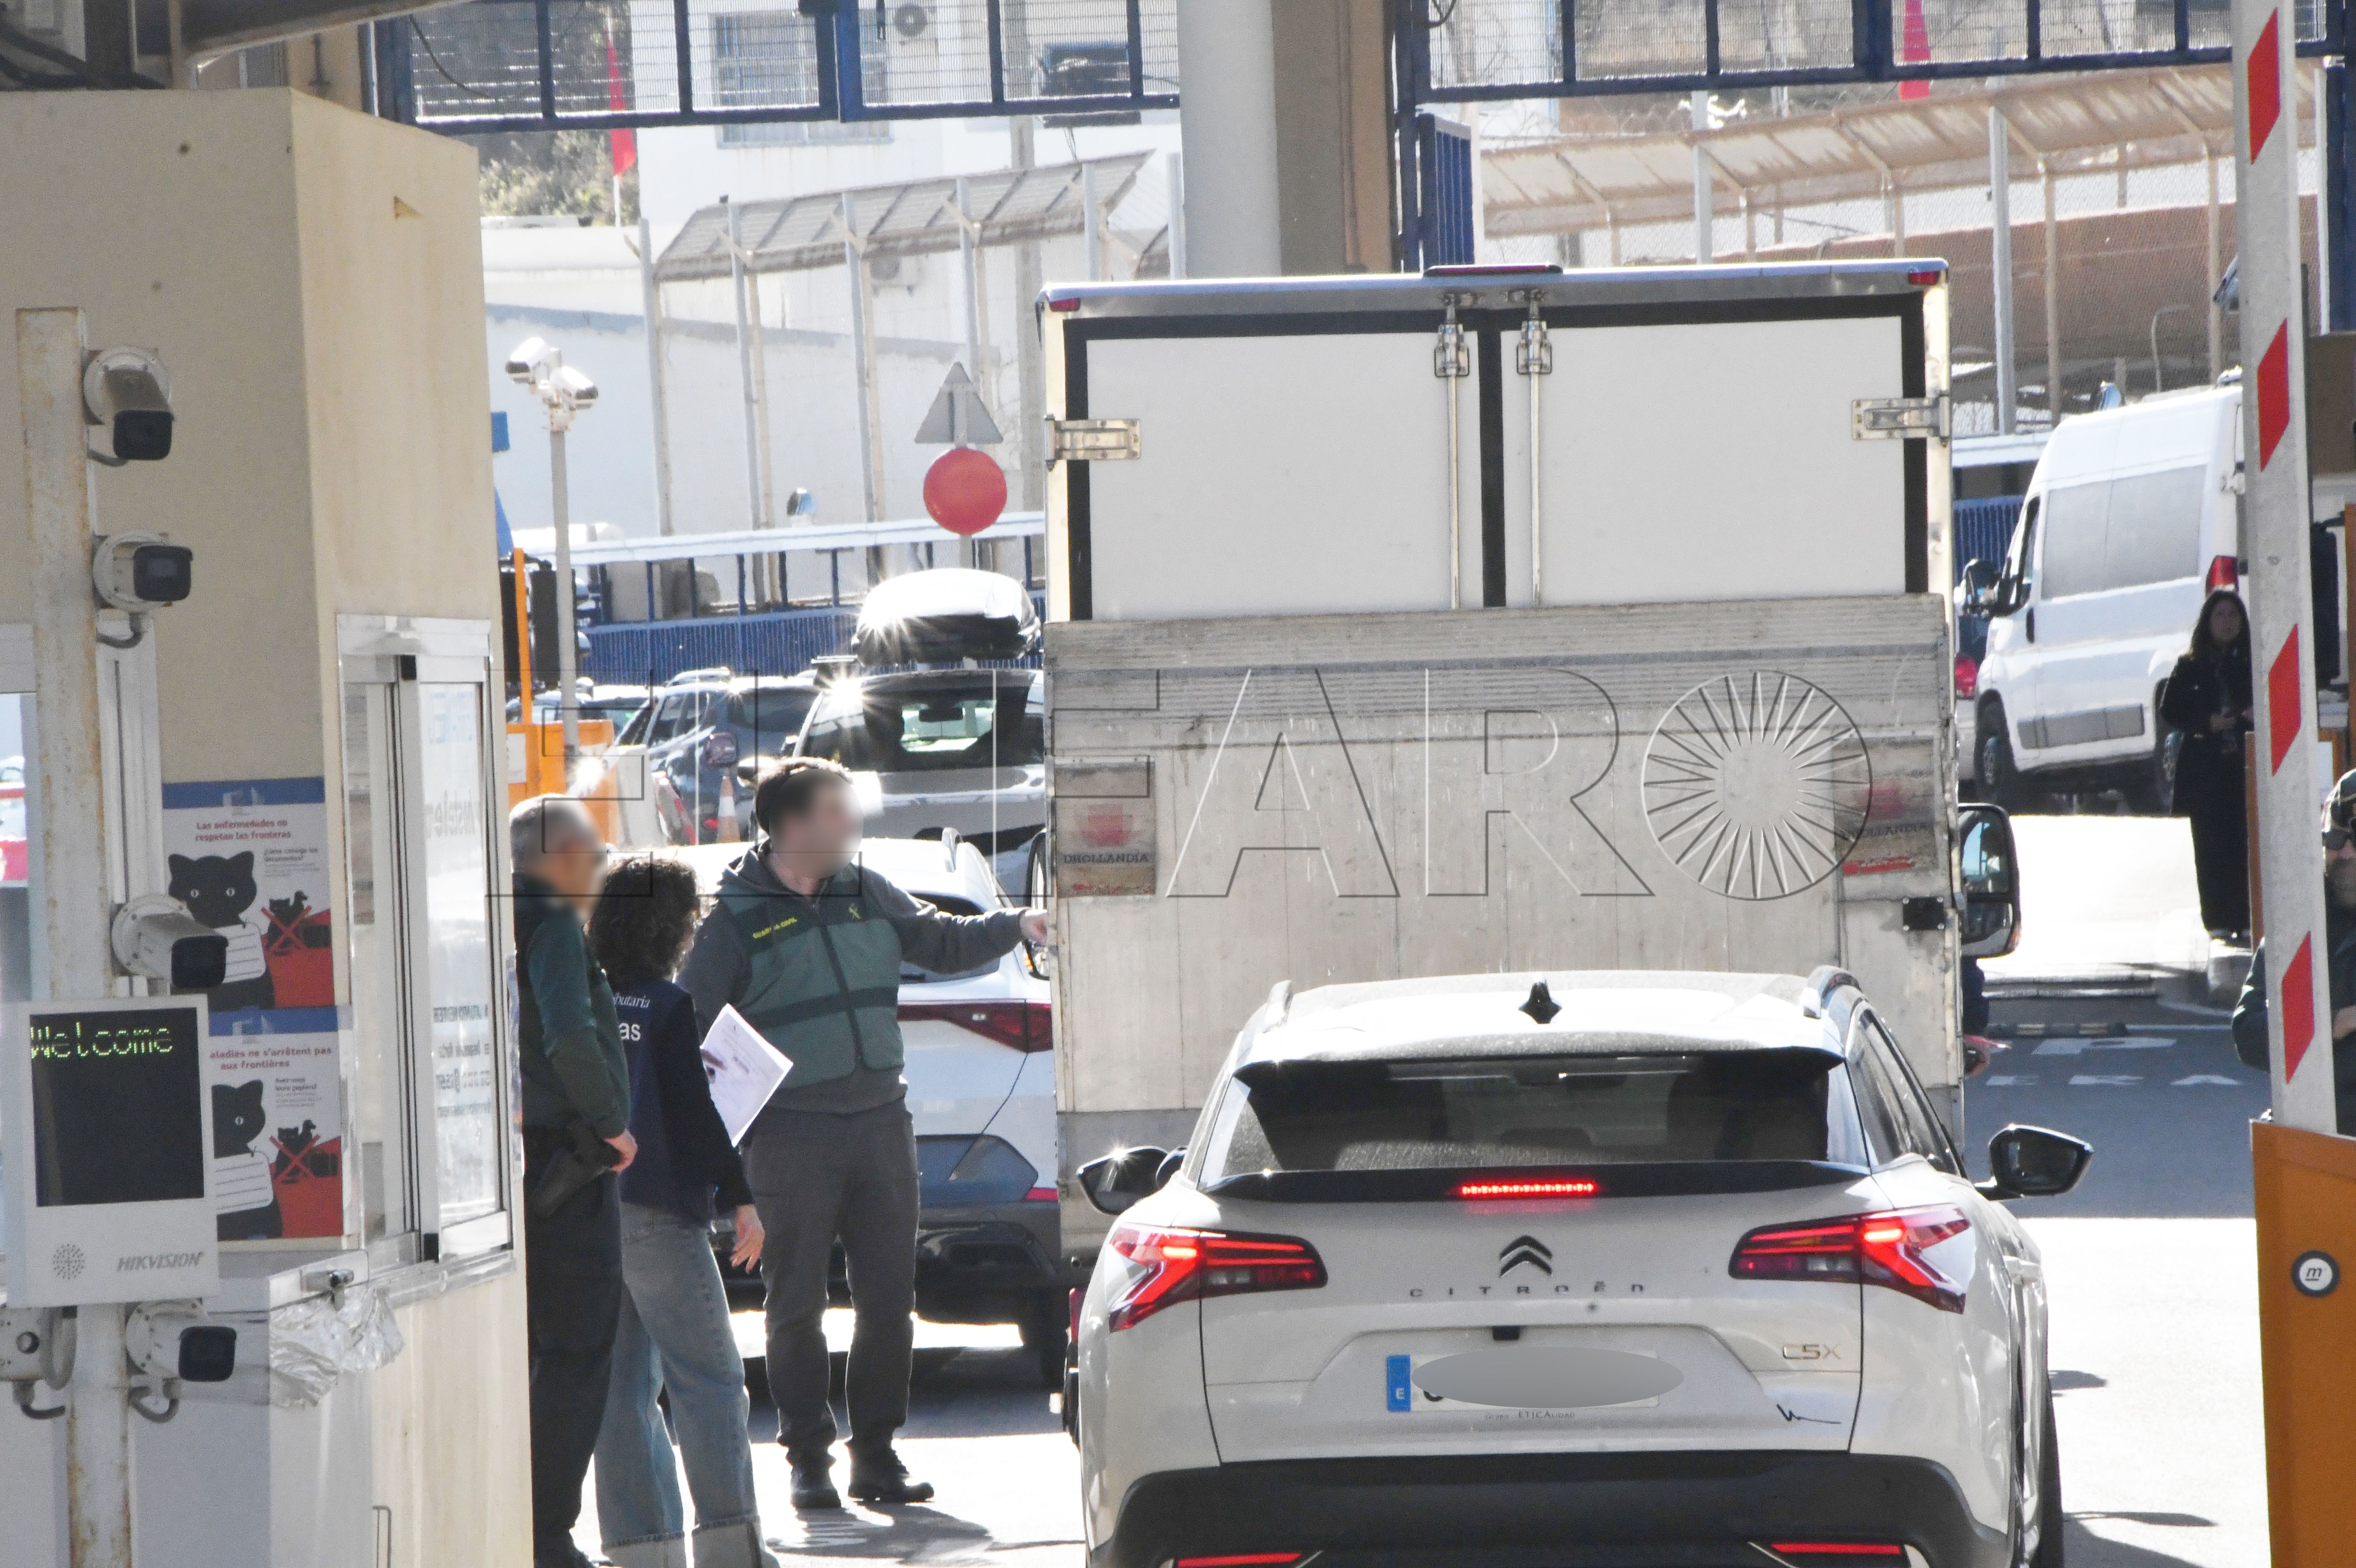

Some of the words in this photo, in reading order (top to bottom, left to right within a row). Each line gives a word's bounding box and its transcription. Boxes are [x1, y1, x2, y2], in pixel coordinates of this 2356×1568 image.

[214, 819, 274, 829] enfermedades
[196, 833, 234, 841] respetan
[1064, 853, 1150, 864] DHOLLANDIA
[619, 1022, 641, 1041] as
[30, 1022, 173, 1059] Welcome
[210, 1050, 245, 1058] aladies
[263, 1047, 311, 1056] s'arrêtent
[314, 1048, 332, 1056] pas
[241, 1060, 290, 1069] frontières
[117, 1252, 203, 1272] HIKVISION
[1395, 1387, 1405, 1400] E
